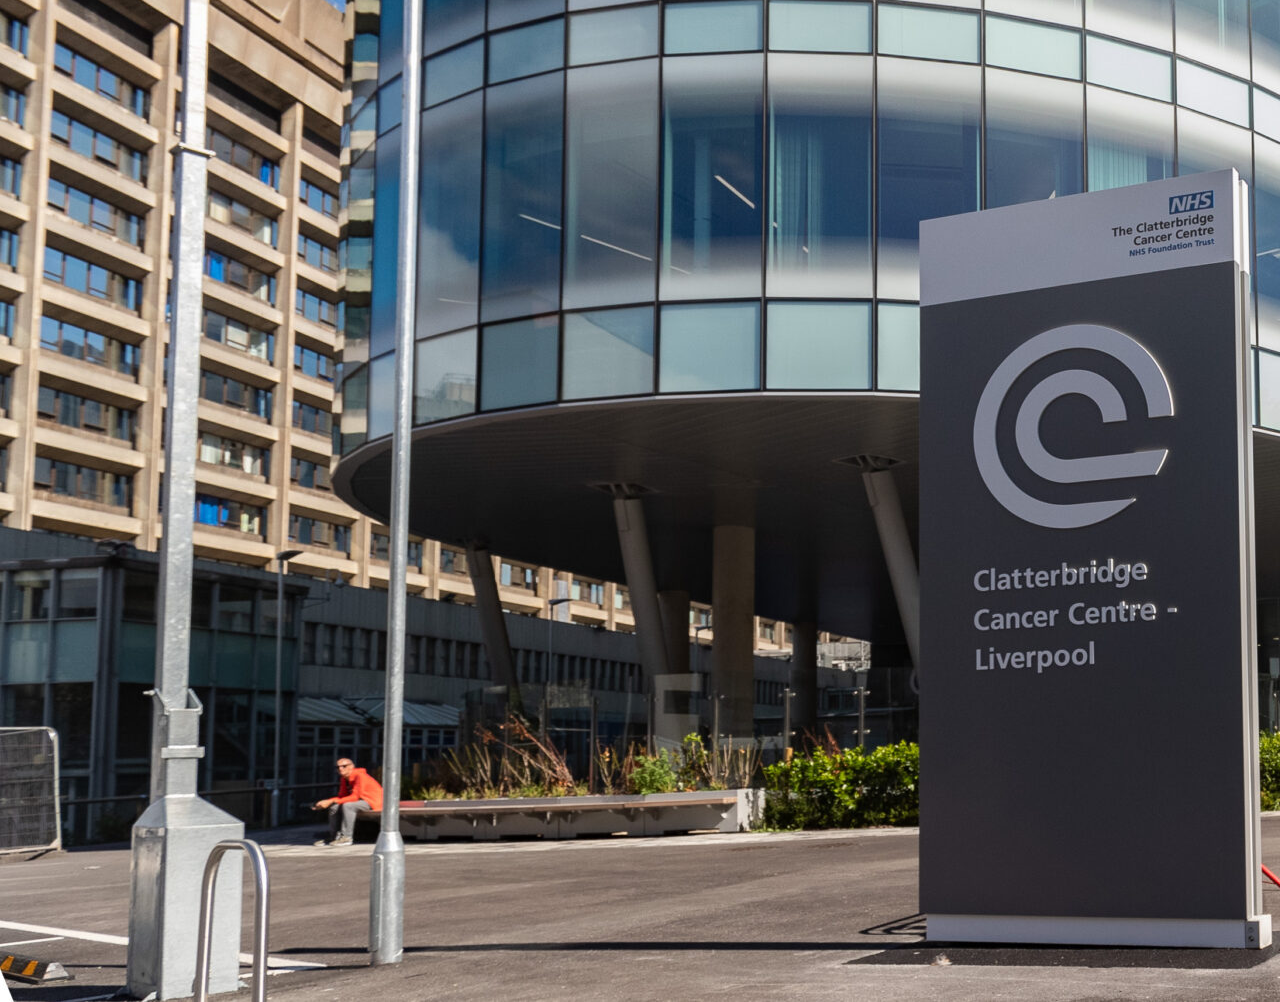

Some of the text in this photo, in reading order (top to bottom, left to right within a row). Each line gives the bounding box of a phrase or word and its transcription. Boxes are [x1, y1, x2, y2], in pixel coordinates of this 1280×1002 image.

[1170, 191, 1212, 213] NHS
[1112, 213, 1214, 237] The Clatterbridge
[1133, 226, 1214, 246] Cancer Centre
[1129, 238, 1215, 257] NHS Foundation Trust
[973, 557, 1149, 592] Clatterbridge
[973, 607, 1060, 631] Cancer
[1068, 600, 1157, 626] Centre
[975, 640, 1095, 674] Liverpool
